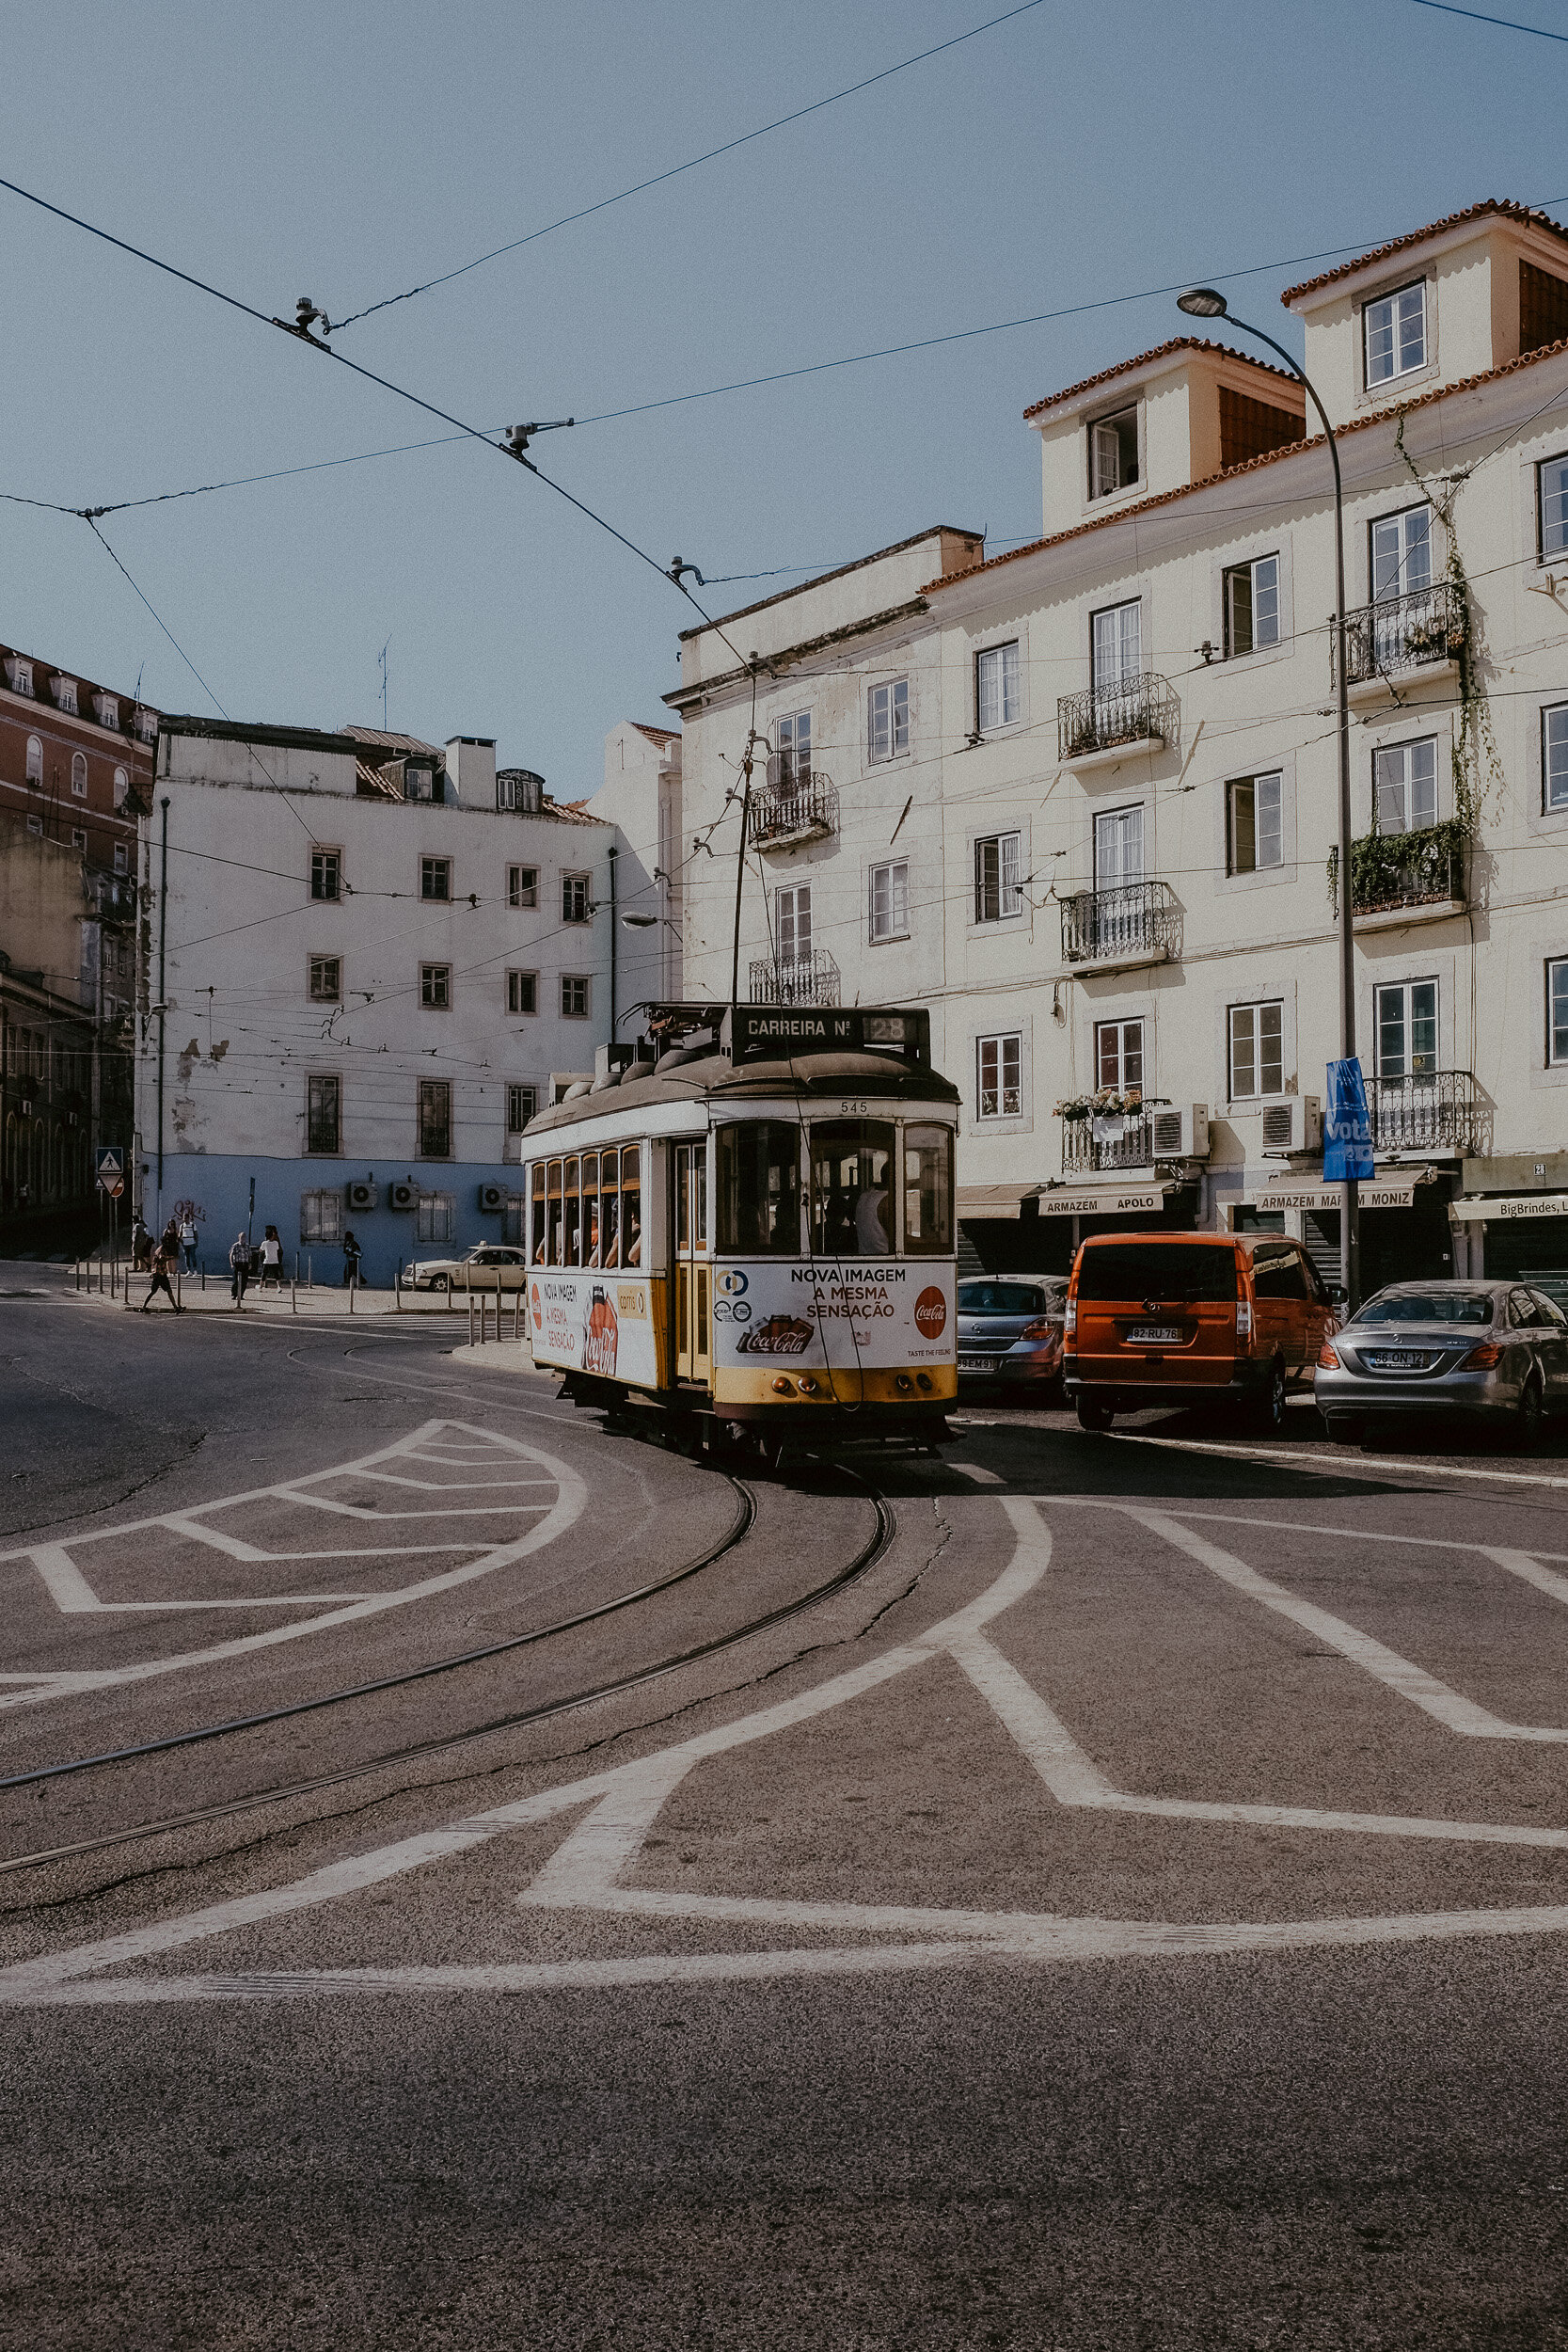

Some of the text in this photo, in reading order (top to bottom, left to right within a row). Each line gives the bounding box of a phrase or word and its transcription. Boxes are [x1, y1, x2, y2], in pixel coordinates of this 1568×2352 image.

[748, 1019, 826, 1036] CARREIRA
[871, 1018, 905, 1040] 28
[841, 1102, 867, 1113] 545
[1535, 1165, 1544, 1174] 28
[1047, 1198, 1154, 1213] ARMAZÉM APOLO
[1371, 1193, 1410, 1205] MONIZ
[1500, 1201, 1560, 1217] BigBrindes,
[791, 1269, 906, 1282] NOVA IMAGEM
[813, 1287, 888, 1300] A MESMA
[806, 1301, 895, 1320] SENSAÇÃO
